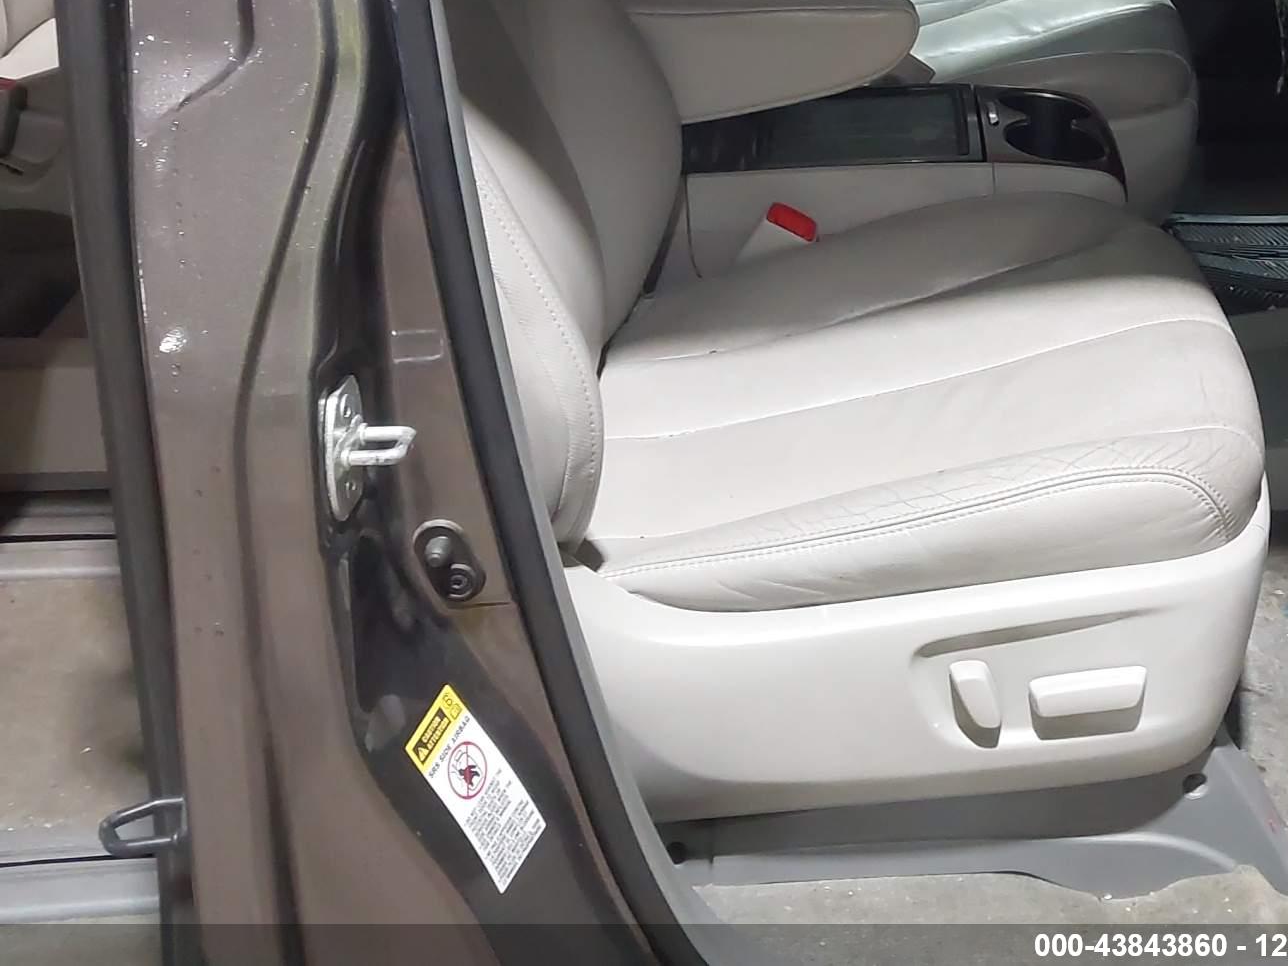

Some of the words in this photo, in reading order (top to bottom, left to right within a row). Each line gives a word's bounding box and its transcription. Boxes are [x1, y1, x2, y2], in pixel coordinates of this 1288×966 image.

[428, 762, 441, 778] SRS
[439, 744, 452, 763] SIDE
[451, 715, 471, 744] AIRBAG
